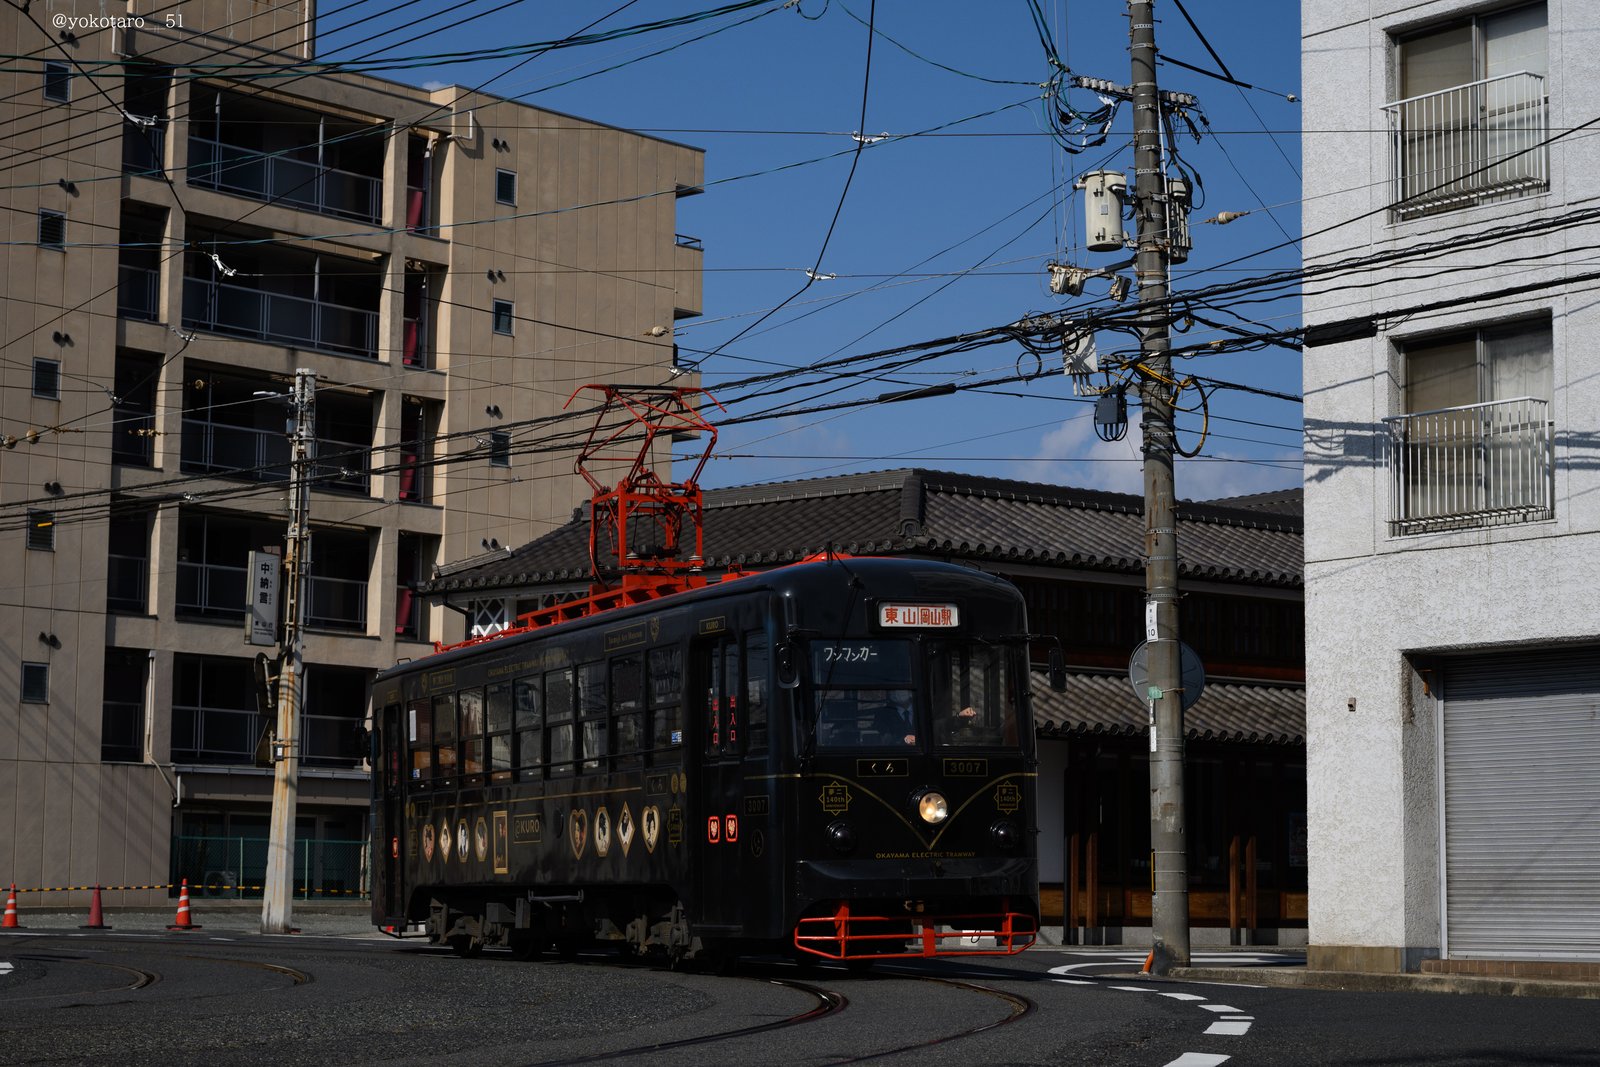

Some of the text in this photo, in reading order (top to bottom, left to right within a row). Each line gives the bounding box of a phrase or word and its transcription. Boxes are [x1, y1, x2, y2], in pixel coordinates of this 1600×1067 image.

[885, 607, 952, 626] 東山 岡山駅
[824, 646, 878, 662] ワンマンカー
[871, 762, 895, 774] くろ
[950, 762, 981, 774] 3007
[875, 851, 910, 859] OKAYAMA
[911, 851, 945, 859] ELECTRIC
